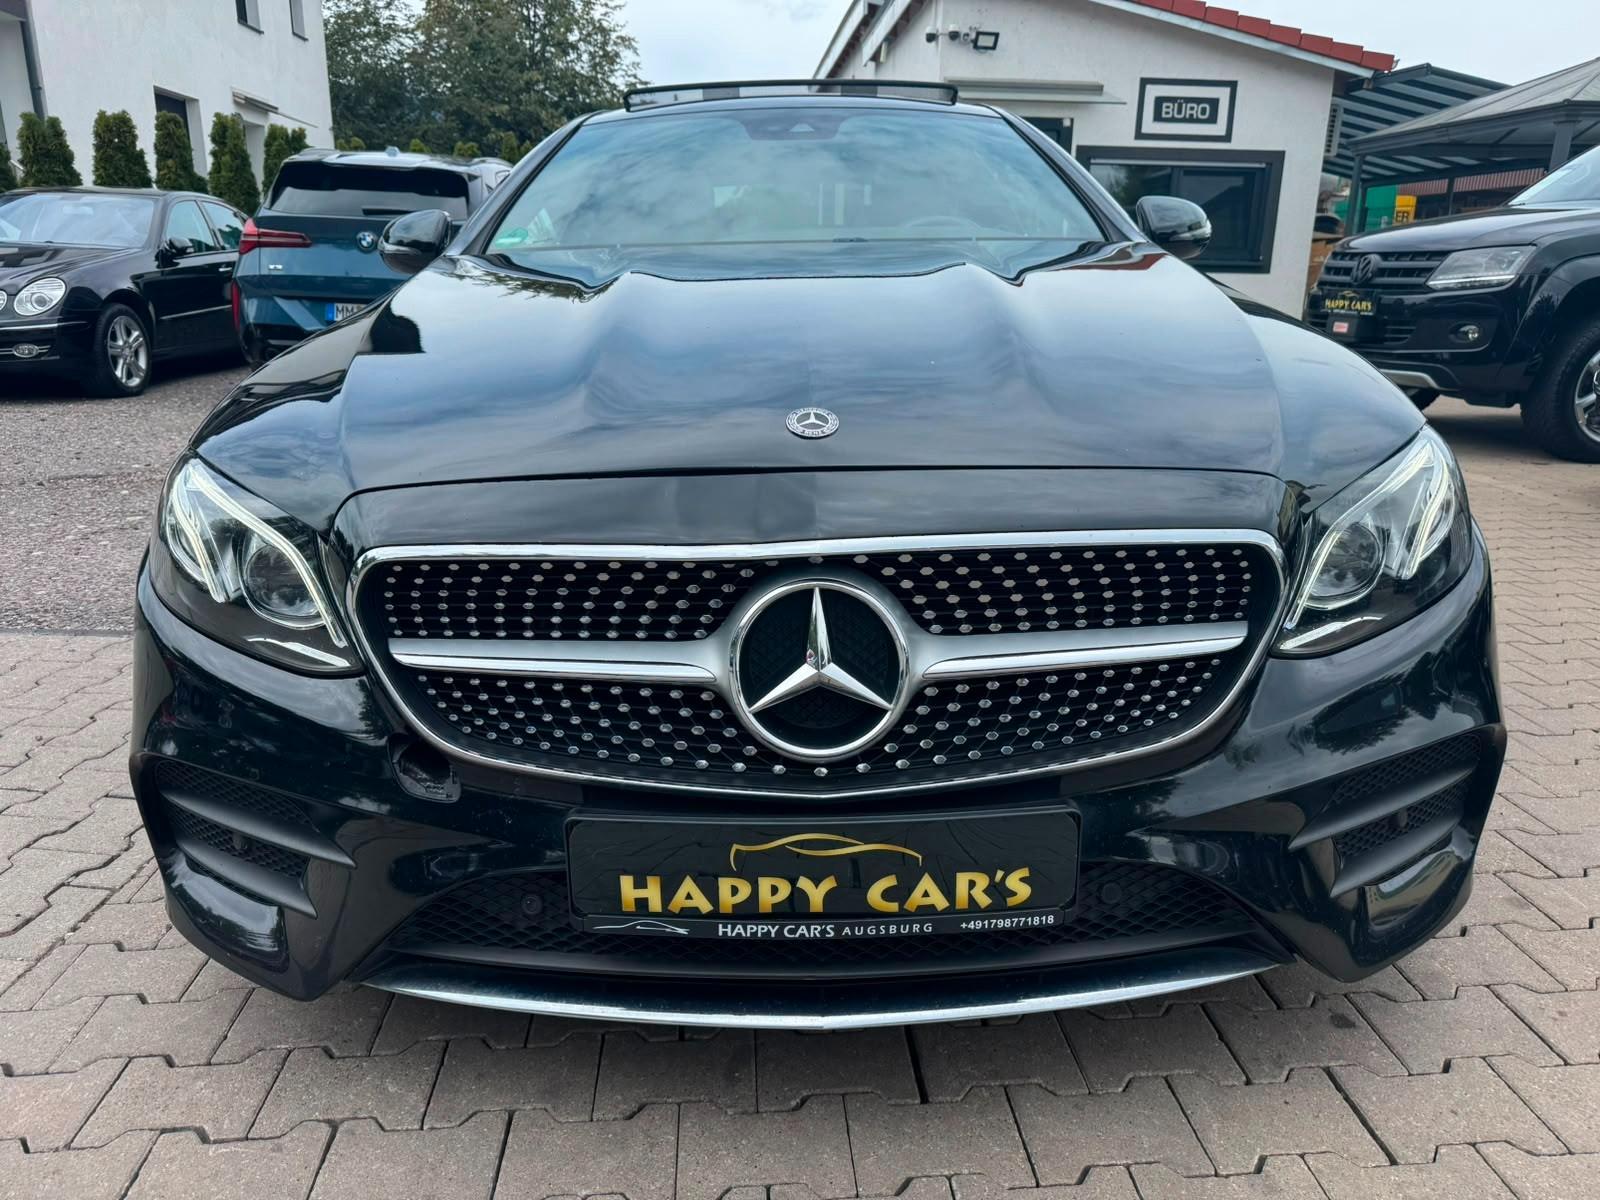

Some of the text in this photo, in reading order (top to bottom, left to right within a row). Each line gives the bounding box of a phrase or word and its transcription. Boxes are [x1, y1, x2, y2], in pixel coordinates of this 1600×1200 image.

[1161, 98, 1210, 119] BÜRO
[619, 867, 1032, 914] HAPPY CAR'S
[718, 922, 933, 938] HAPPY CAR'S AUGSBURG
[960, 914, 1055, 931] +491798771818
